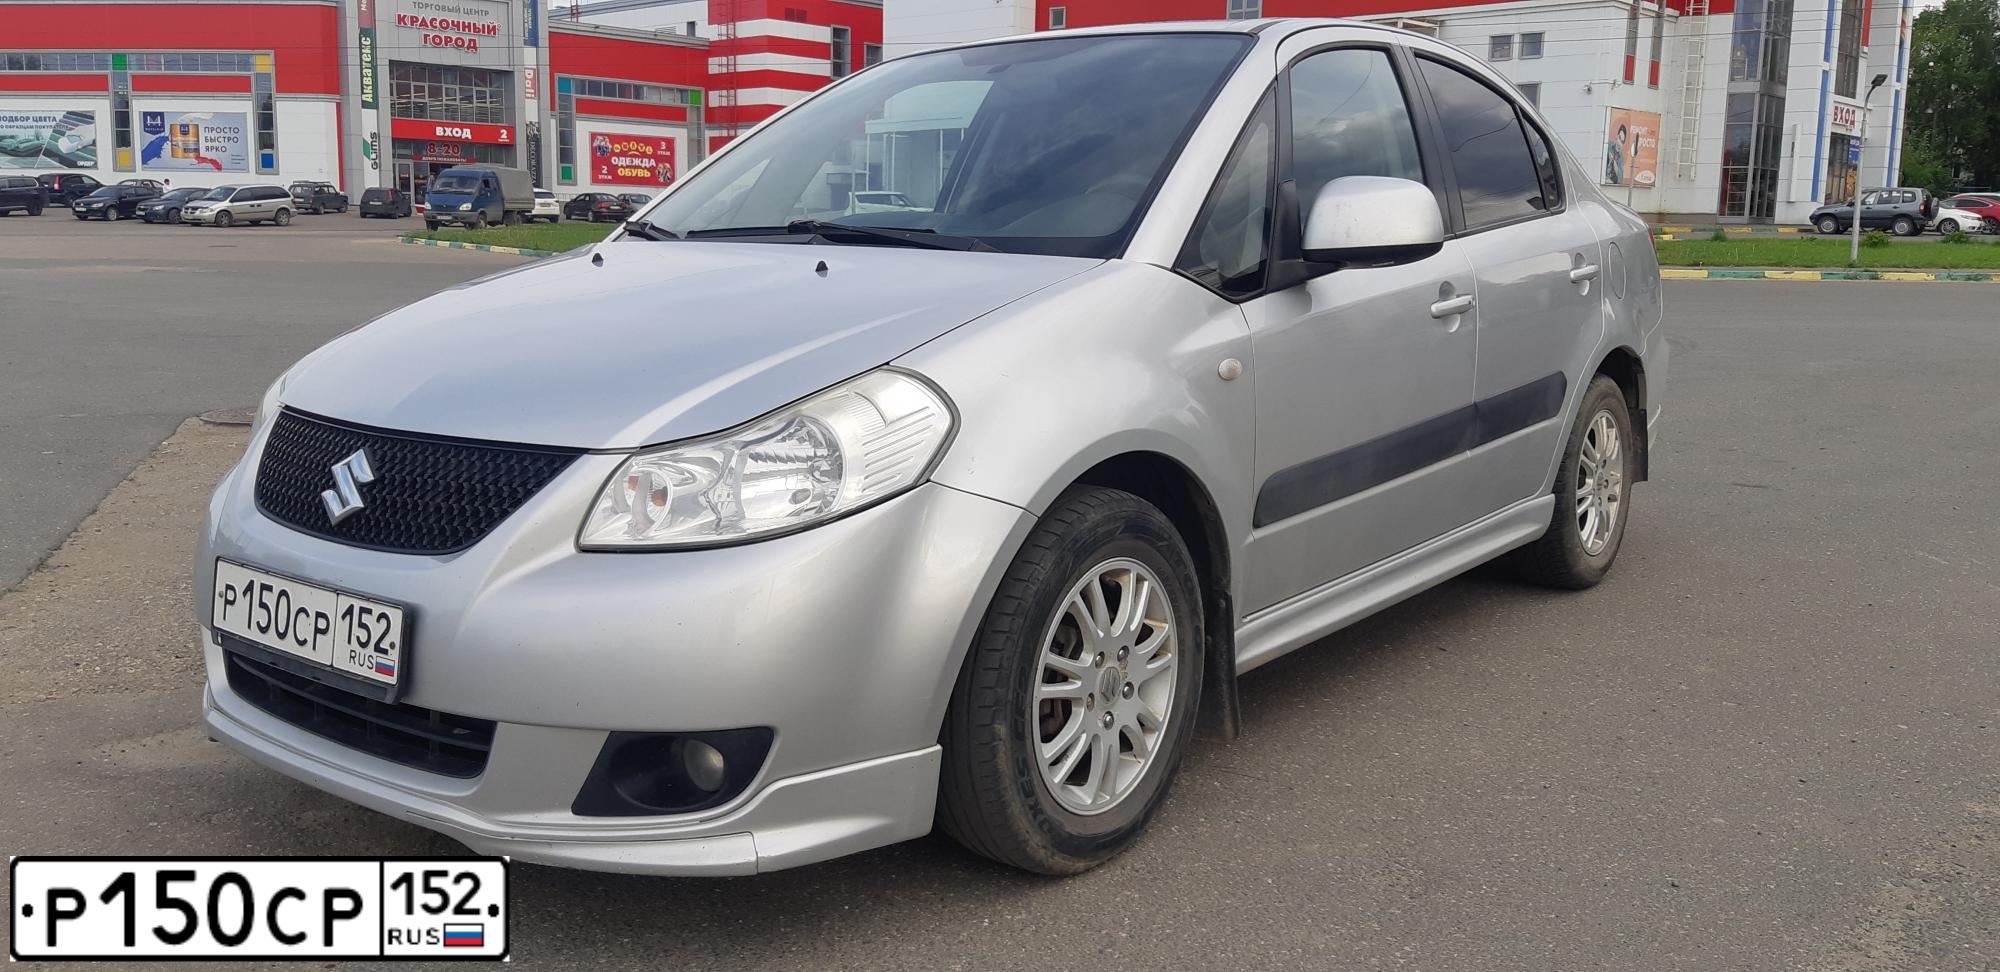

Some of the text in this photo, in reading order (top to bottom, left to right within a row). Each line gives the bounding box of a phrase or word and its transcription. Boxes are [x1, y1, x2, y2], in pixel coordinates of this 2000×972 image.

[412, 1, 490, 16] ТОРГОВЫЙ ЦЕНТР
[396, 13, 498, 36] КРАСОЧНЫЙ
[423, 33, 478, 52] ГОРОД
[525, 69, 535, 98] Dali
[32, 115, 58, 123] ЦВЕТА
[1833, 105, 1856, 126] ВХОД
[204, 126, 240, 134] ПРОСТО
[435, 126, 508, 139] ВХОД 2
[204, 136, 239, 144] БЫСТРО
[660, 141, 666, 150] 3
[611, 156, 656, 168] ОДЕЖДА
[601, 165, 608, 174] 2
[617, 167, 651, 178] ОБУВЬ
[223, 579, 392, 655] Р150СР 152
[349, 649, 374, 670] RUS
